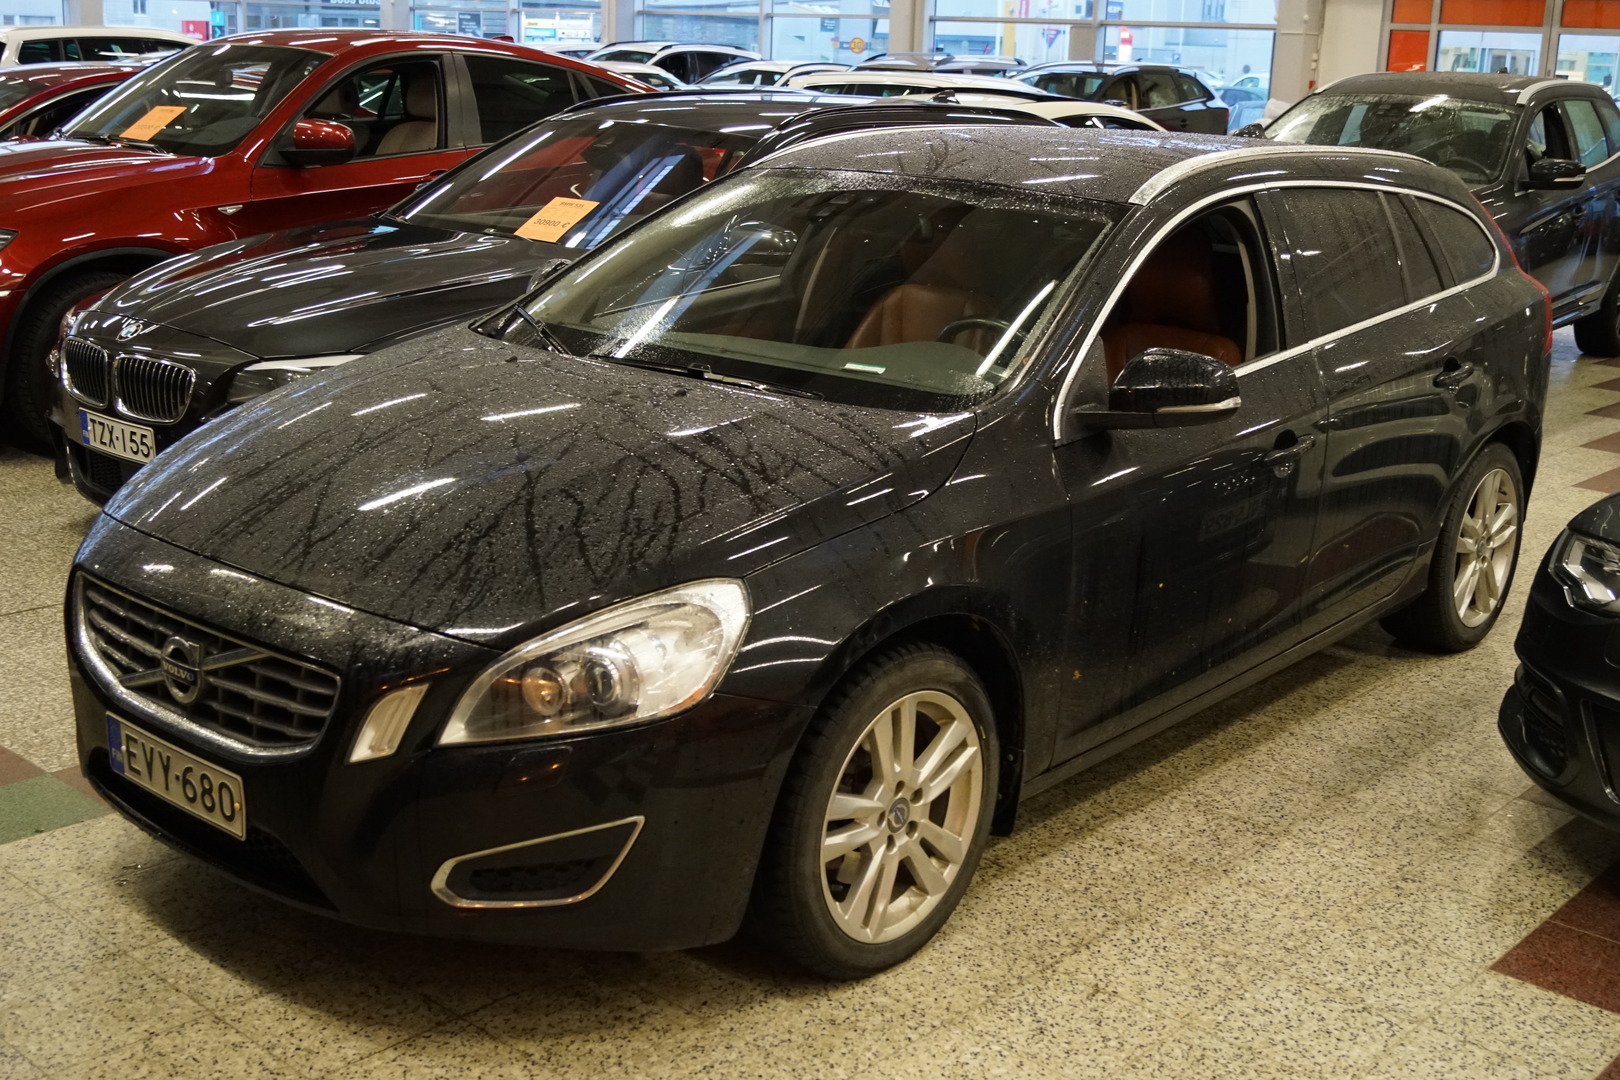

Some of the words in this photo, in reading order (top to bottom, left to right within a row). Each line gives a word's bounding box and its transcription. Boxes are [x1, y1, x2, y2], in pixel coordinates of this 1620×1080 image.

[533, 218, 561, 228] 30900
[89, 417, 151, 458] TZX-155
[162, 660, 194, 682] VOLVO
[125, 732, 236, 823] EVY-680
